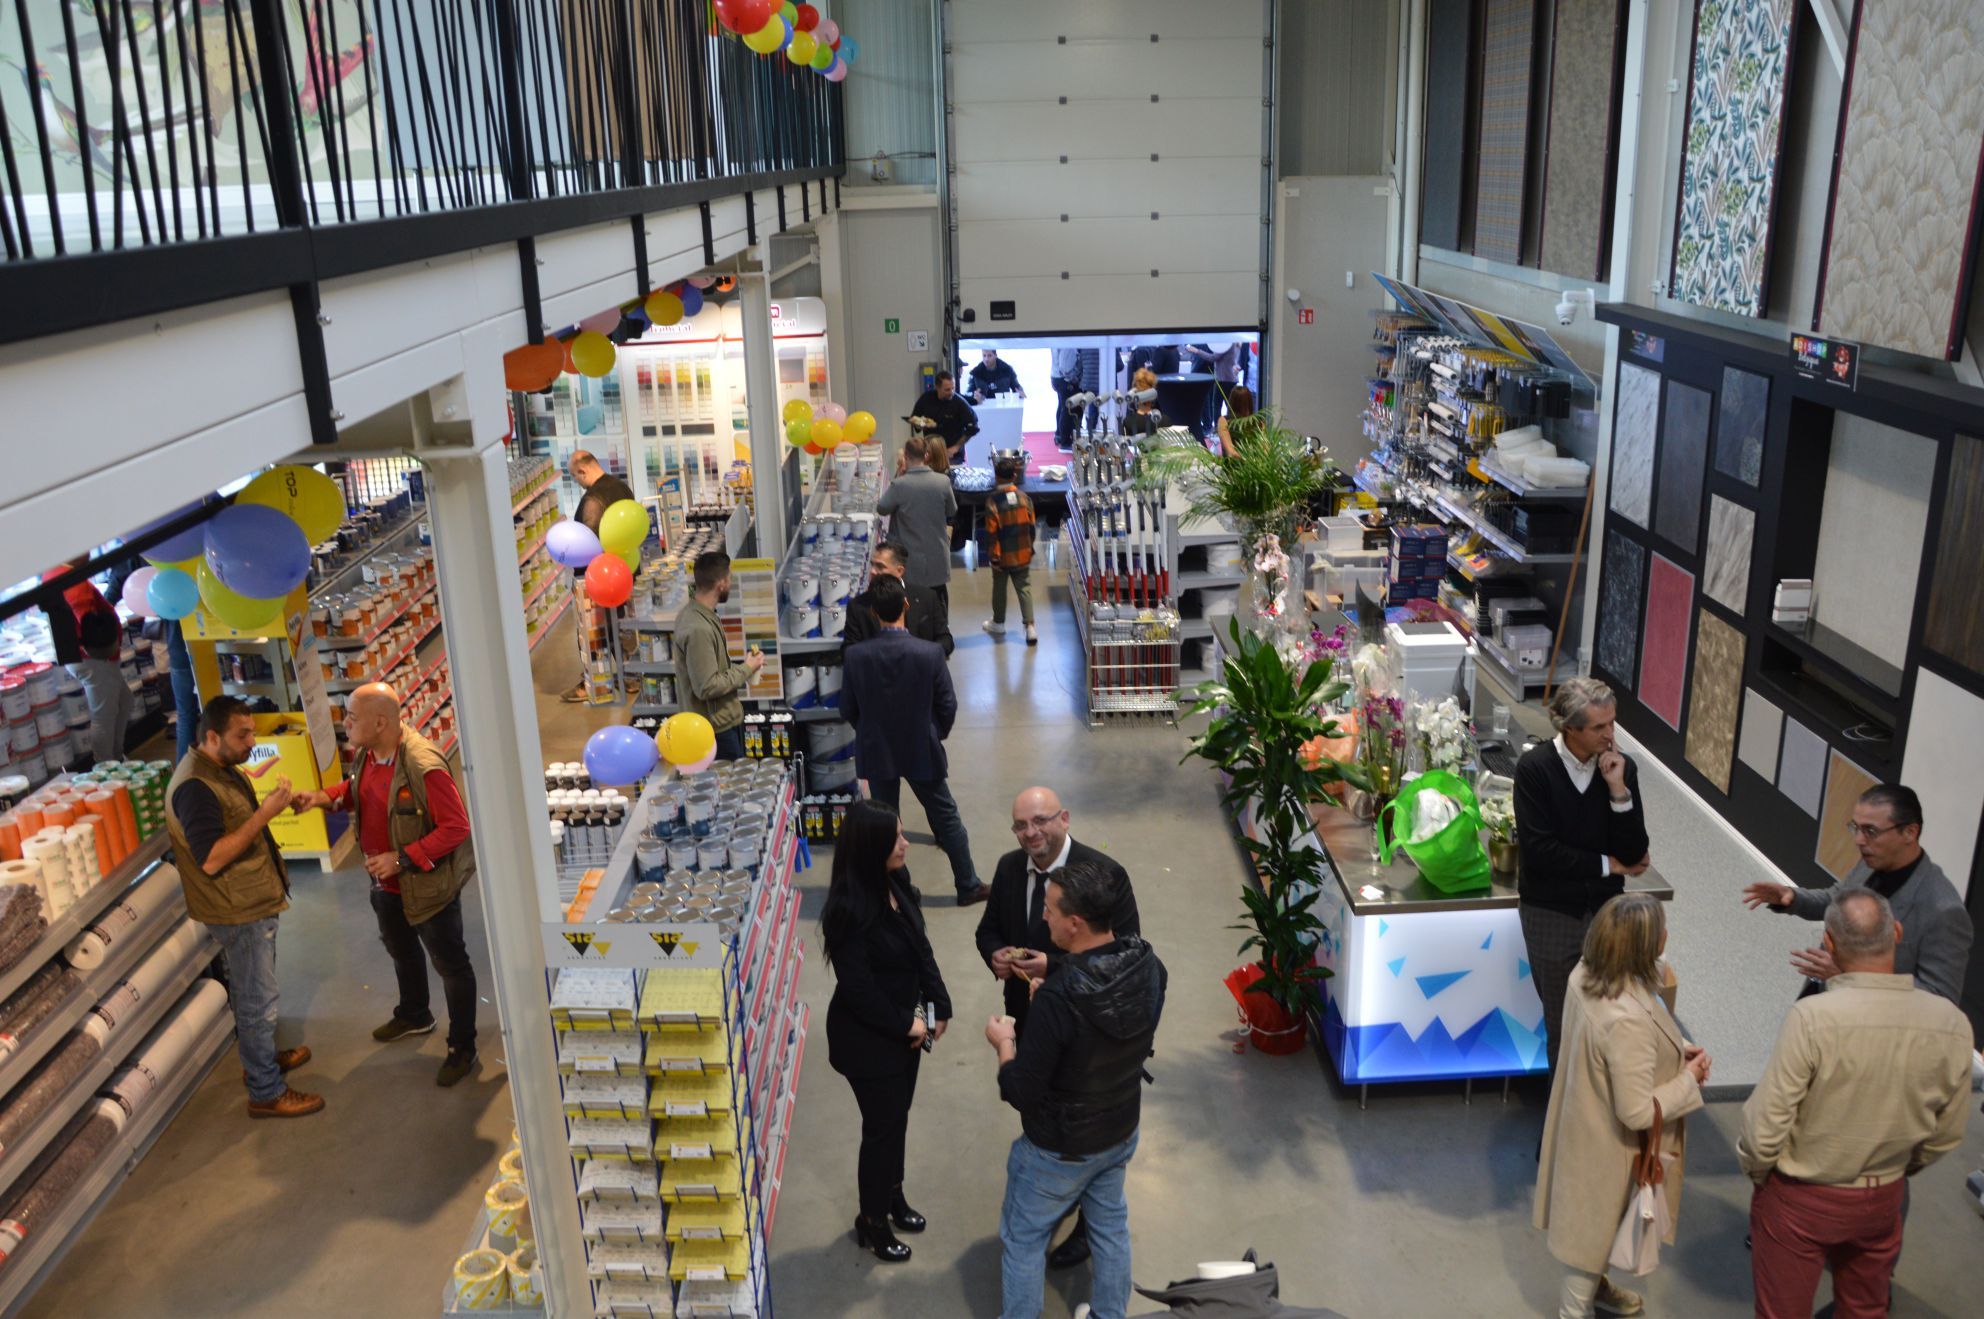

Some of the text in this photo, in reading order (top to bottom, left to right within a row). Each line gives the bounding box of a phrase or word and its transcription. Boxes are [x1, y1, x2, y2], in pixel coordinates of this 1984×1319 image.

[285, 470, 298, 498] TOP
[563, 932, 595, 944] sia
[650, 932, 683, 944] sia
